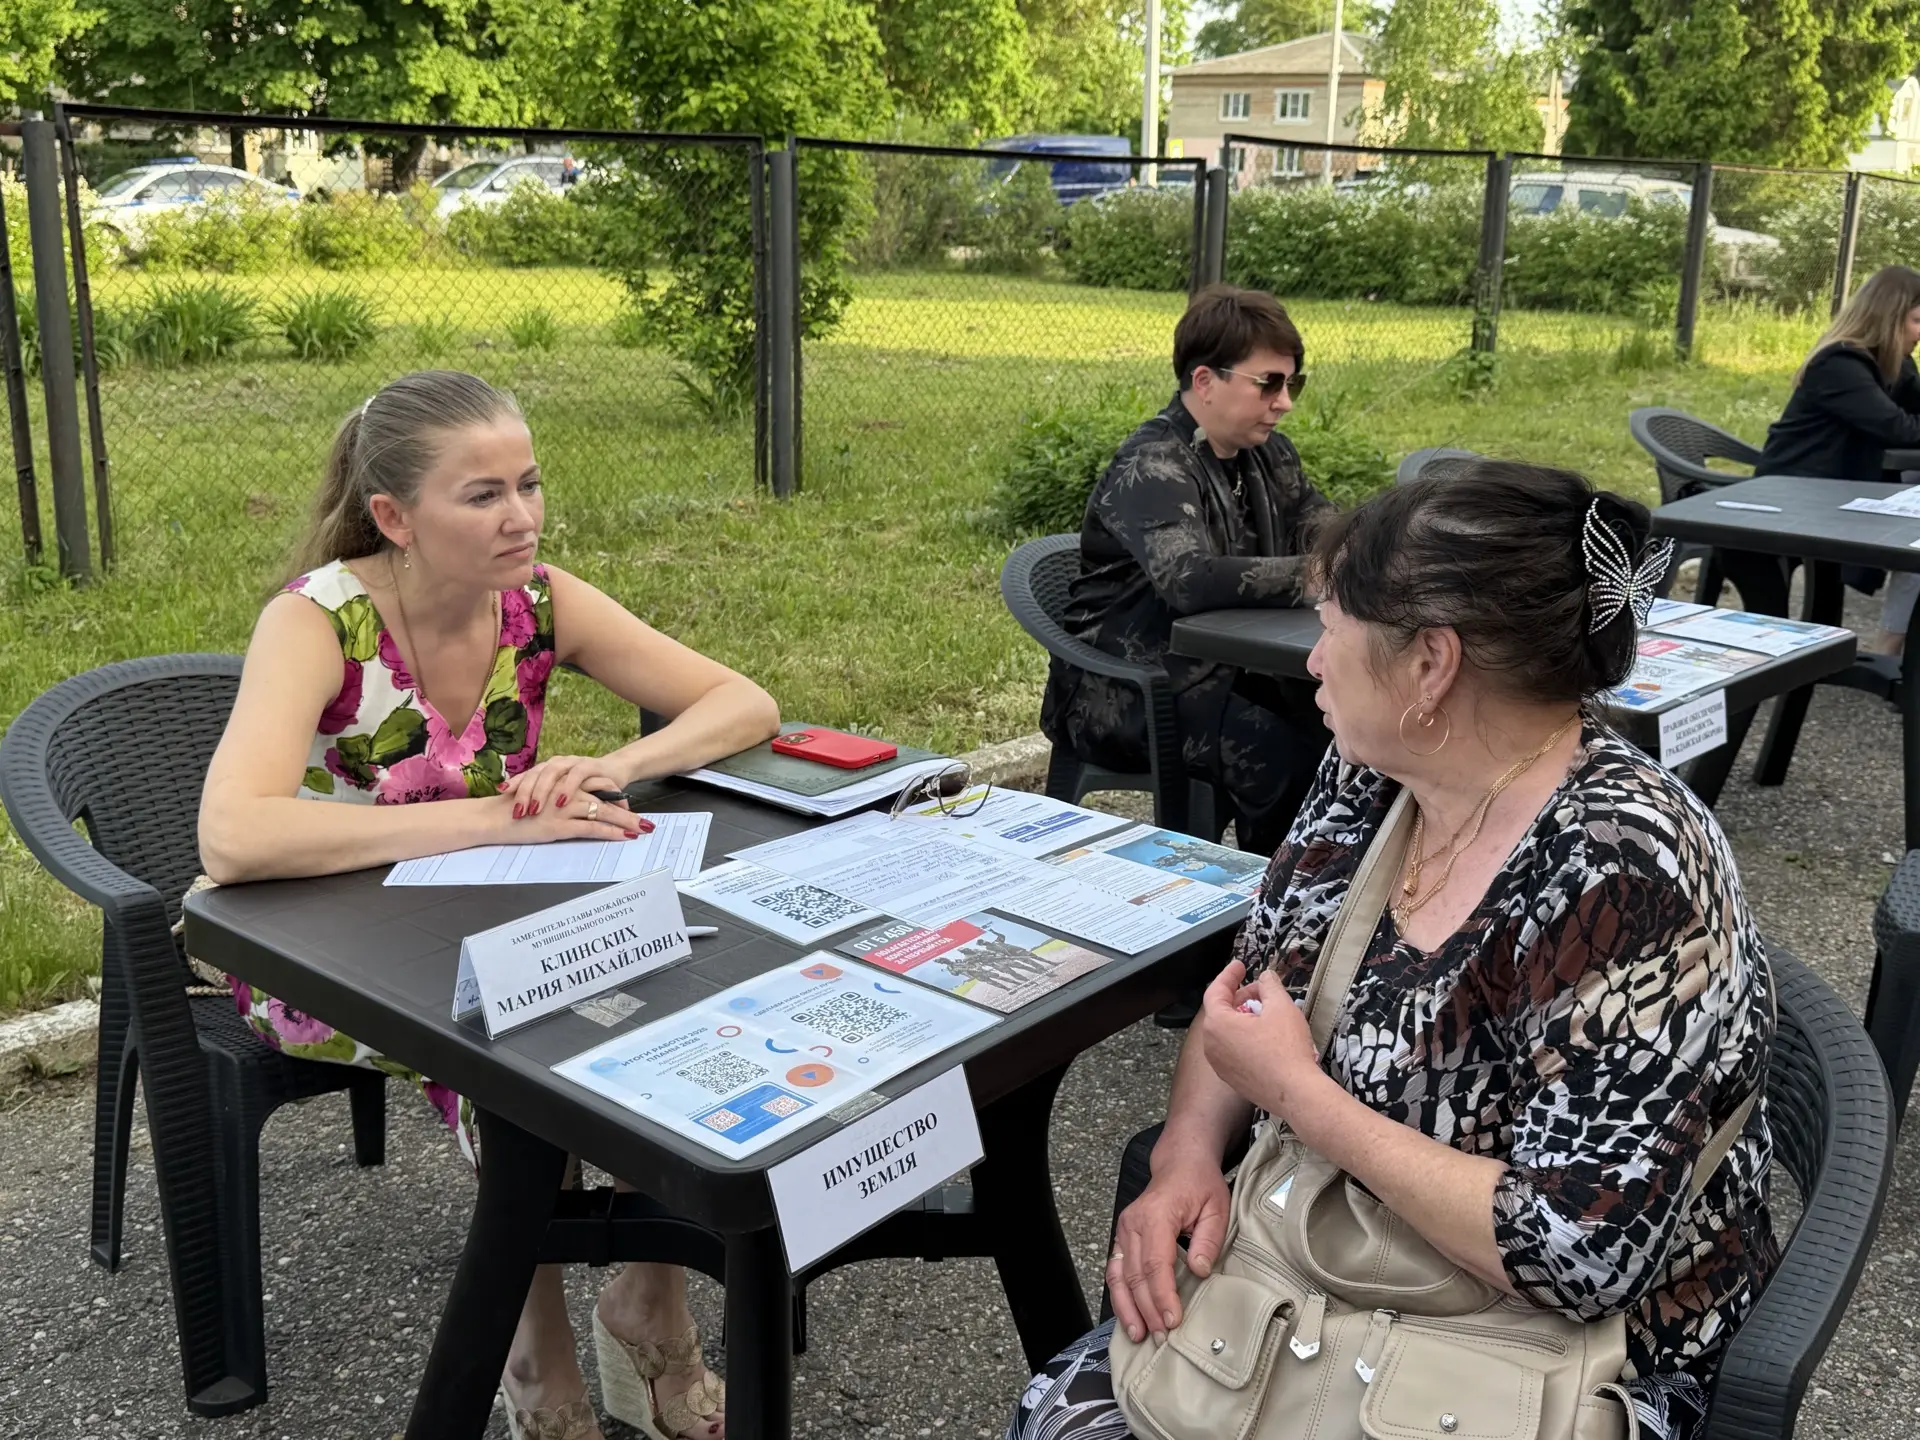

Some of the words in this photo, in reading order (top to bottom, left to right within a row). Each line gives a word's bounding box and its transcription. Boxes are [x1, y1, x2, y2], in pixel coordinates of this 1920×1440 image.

[511, 917, 565, 946] ЗАМЕСТИТЕЛЬ
[566, 907, 592, 927] ГЛАВЫ
[593, 889, 647, 918] МОЖАЙСКОГО
[531, 916, 605, 950] МУНИЦИПАЛЬНОГО
[605, 906, 635, 925] ОКРУГА
[853, 938, 878, 951] ОТ
[872, 935, 886, 944] 5
[883, 924, 914, 938] 450
[540, 924, 639, 975] КЛИНСКИХ
[894, 956, 909, 965] ЗА
[496, 977, 564, 1017] МАРИЯ
[565, 929, 685, 989] МИХАЙЛОВНА
[621, 1050, 652, 1067] ИТОГИ
[651, 1034, 688, 1052] РАБОТЫ
[646, 1045, 680, 1062] ПЛАНЫ
[822, 1112, 938, 1191] ИМУЩЕСТВО
[857, 1151, 918, 1200] ЗЕМЛЯ
